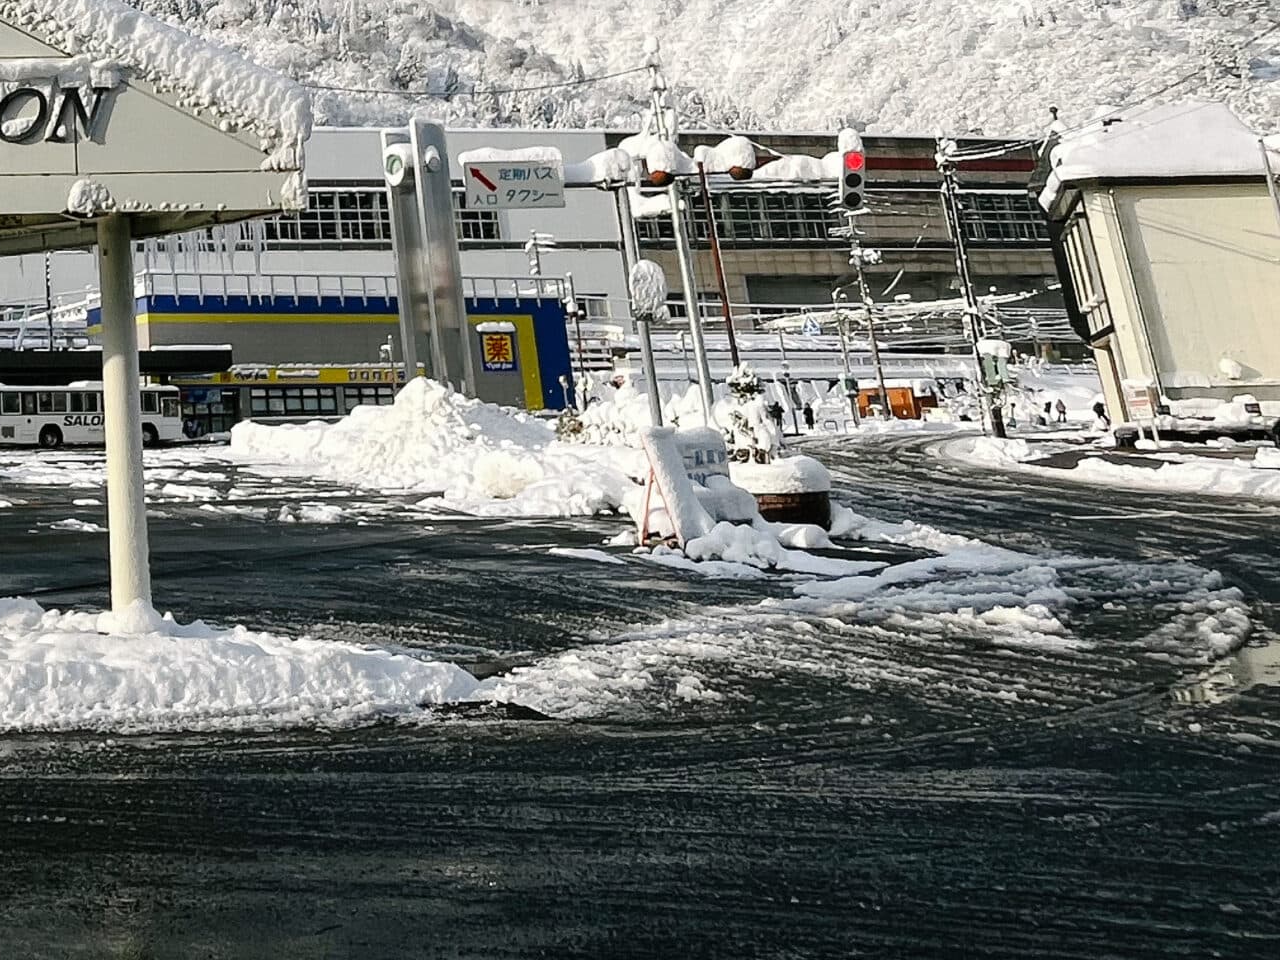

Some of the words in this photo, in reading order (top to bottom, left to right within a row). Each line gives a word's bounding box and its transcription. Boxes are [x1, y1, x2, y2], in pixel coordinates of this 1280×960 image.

[499, 167, 553, 180] 定期バス
[506, 189, 559, 202] タクシー
[486, 335, 510, 361] 薬
